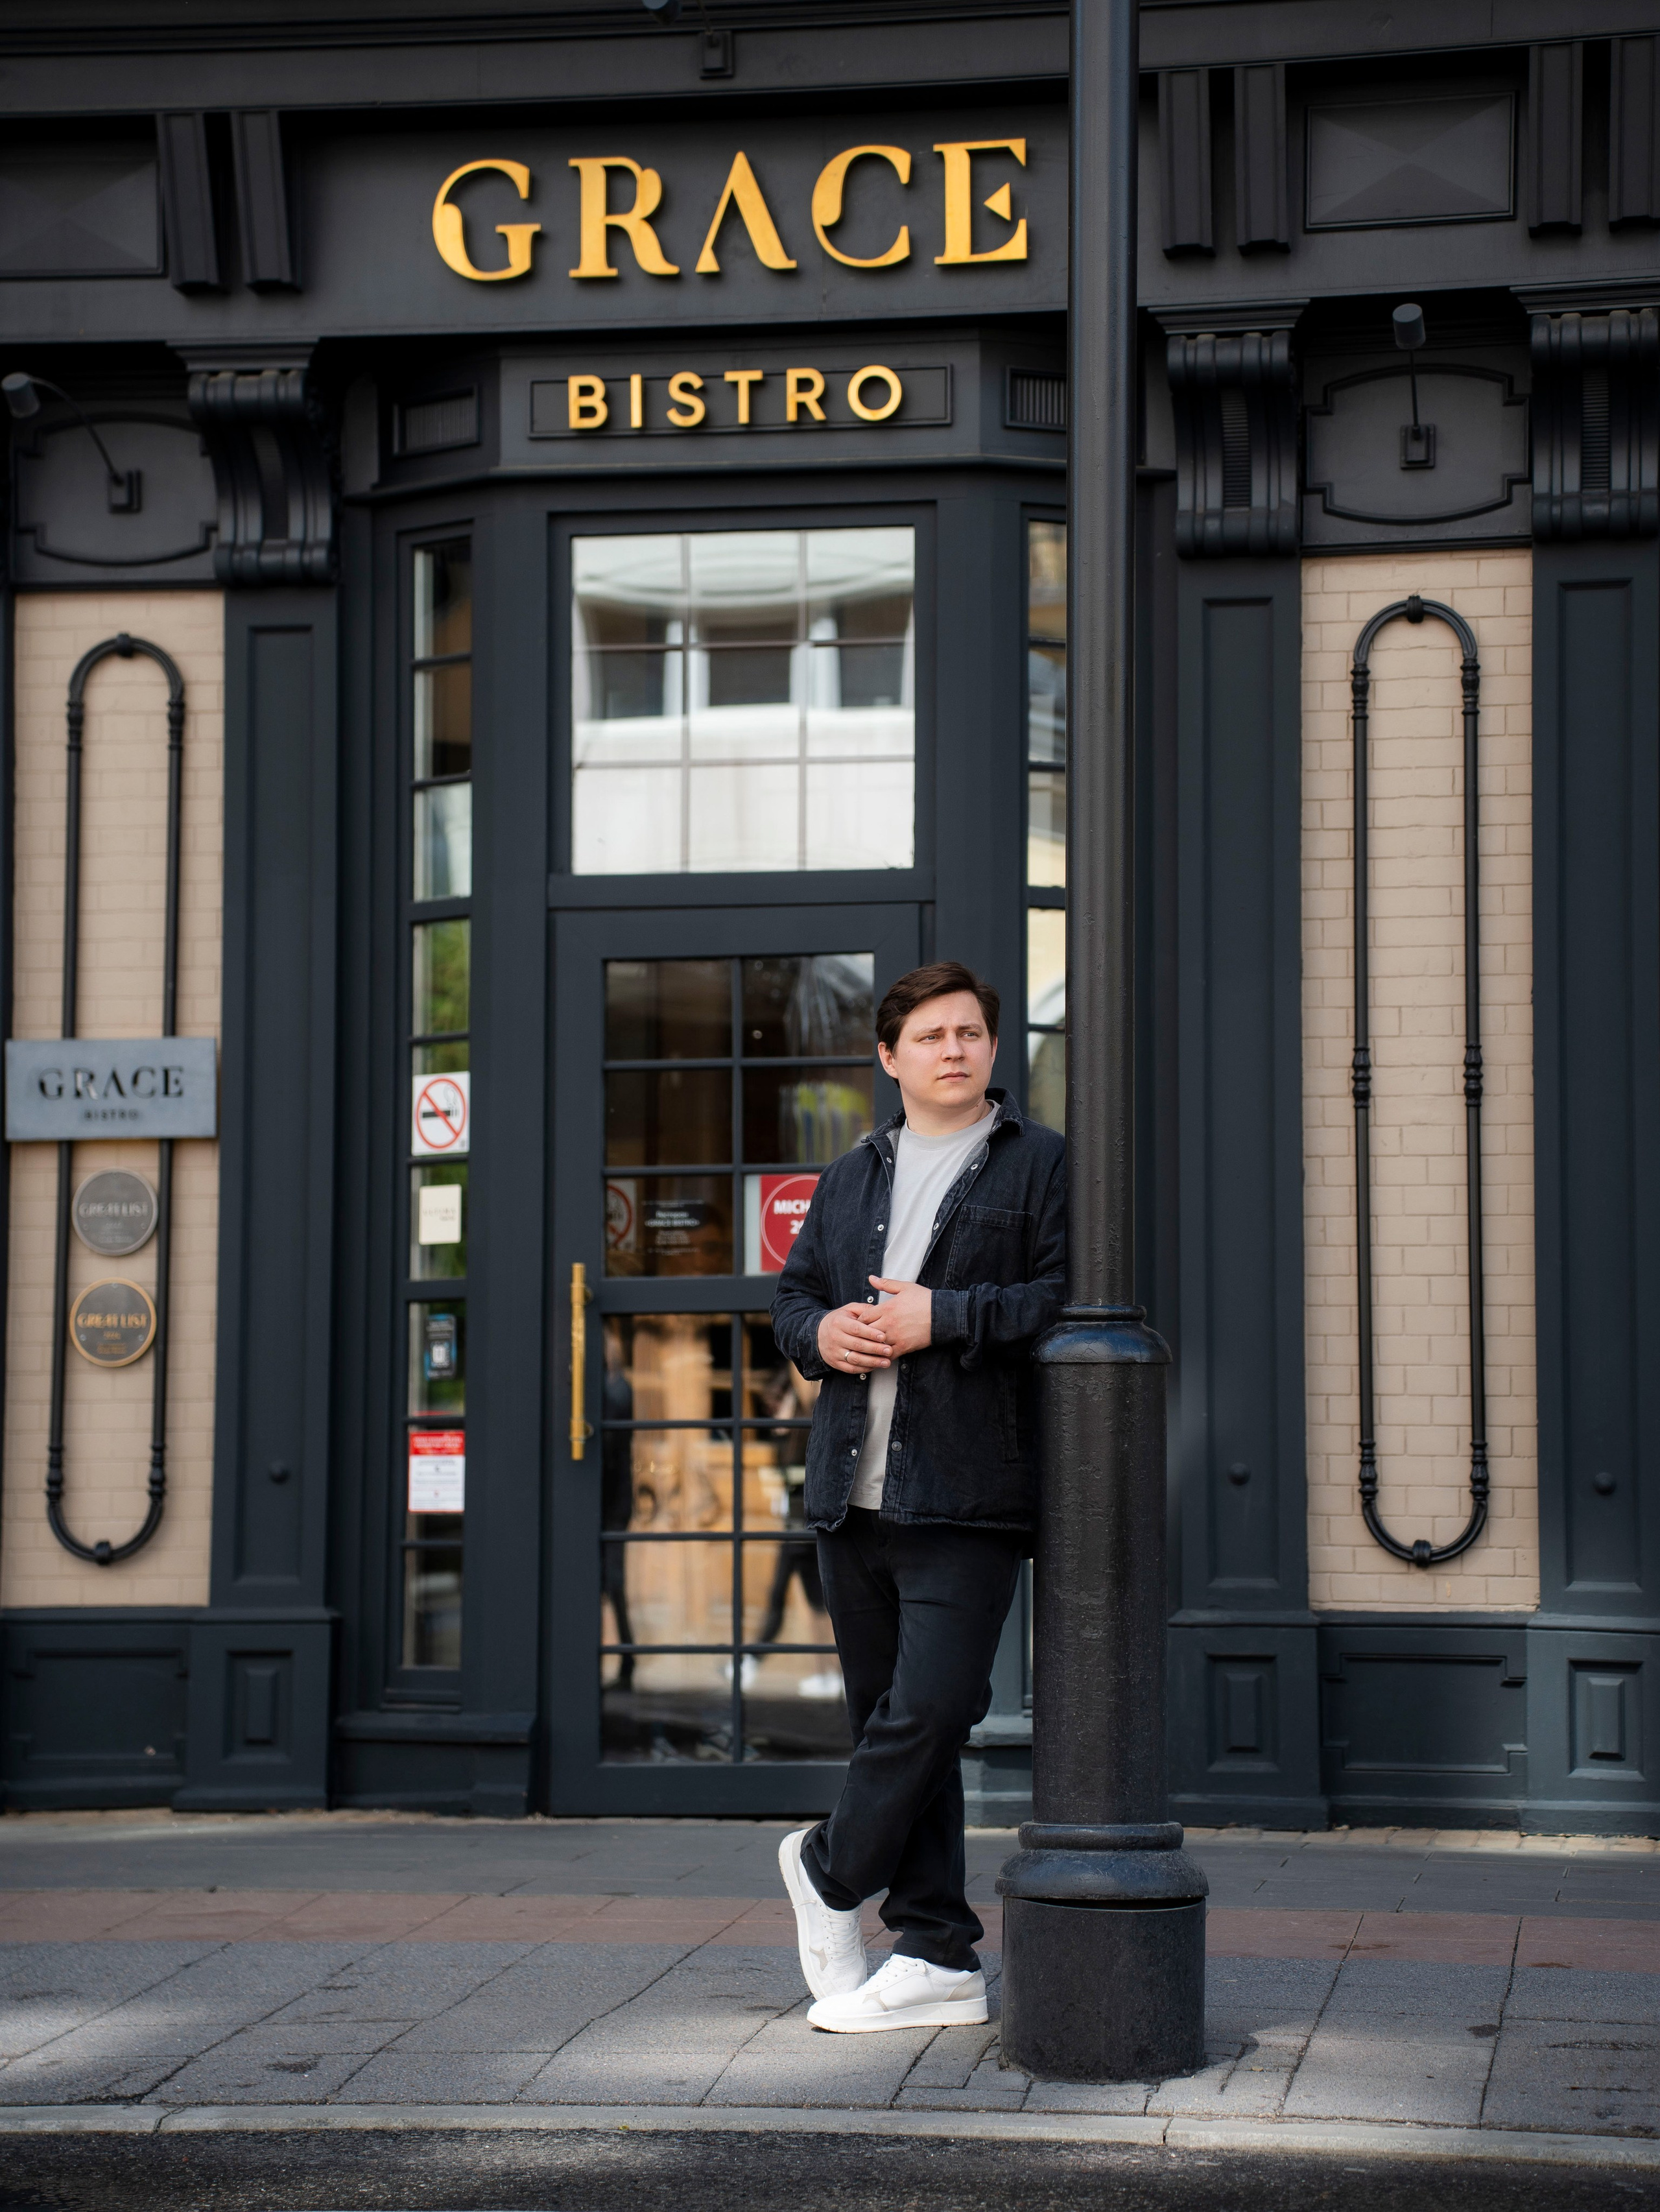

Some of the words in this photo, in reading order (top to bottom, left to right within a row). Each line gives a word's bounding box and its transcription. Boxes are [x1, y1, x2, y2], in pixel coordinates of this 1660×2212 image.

[432, 137, 1028, 281] GRACE
[568, 364, 903, 429] BISTRO
[38, 1065, 184, 1100] GRACE
[84, 1108, 139, 1121] BISTRO
[774, 1199, 811, 1215] MICH
